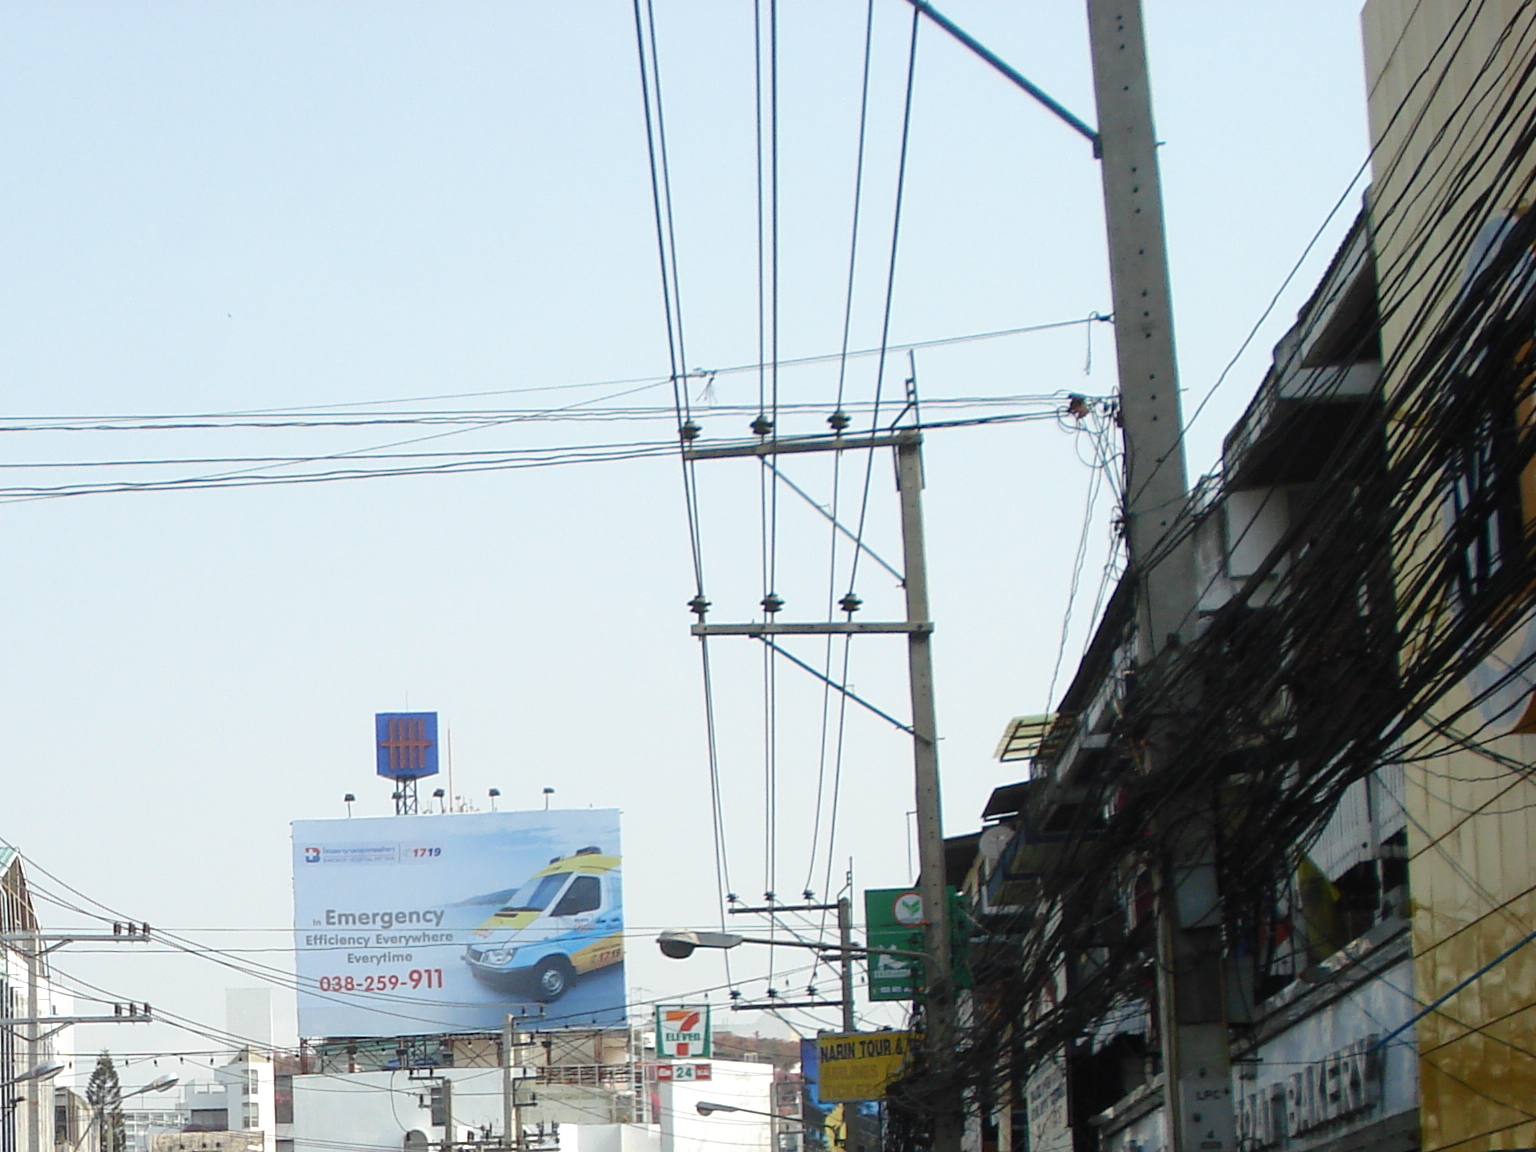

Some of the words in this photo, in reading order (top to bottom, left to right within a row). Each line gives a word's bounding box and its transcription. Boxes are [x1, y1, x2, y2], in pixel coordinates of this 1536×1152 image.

[412, 848, 442, 858] 1719
[325, 908, 445, 930] Emergency
[306, 934, 371, 948] Efficiency
[376, 931, 453, 946] Everywhere
[347, 951, 413, 966] Everytime
[319, 968, 443, 993] 038-259-911
[859, 1039, 892, 1059] TOUR
[676, 1067, 693, 1079] 24
[1286, 1034, 1382, 1138] BAKERY
